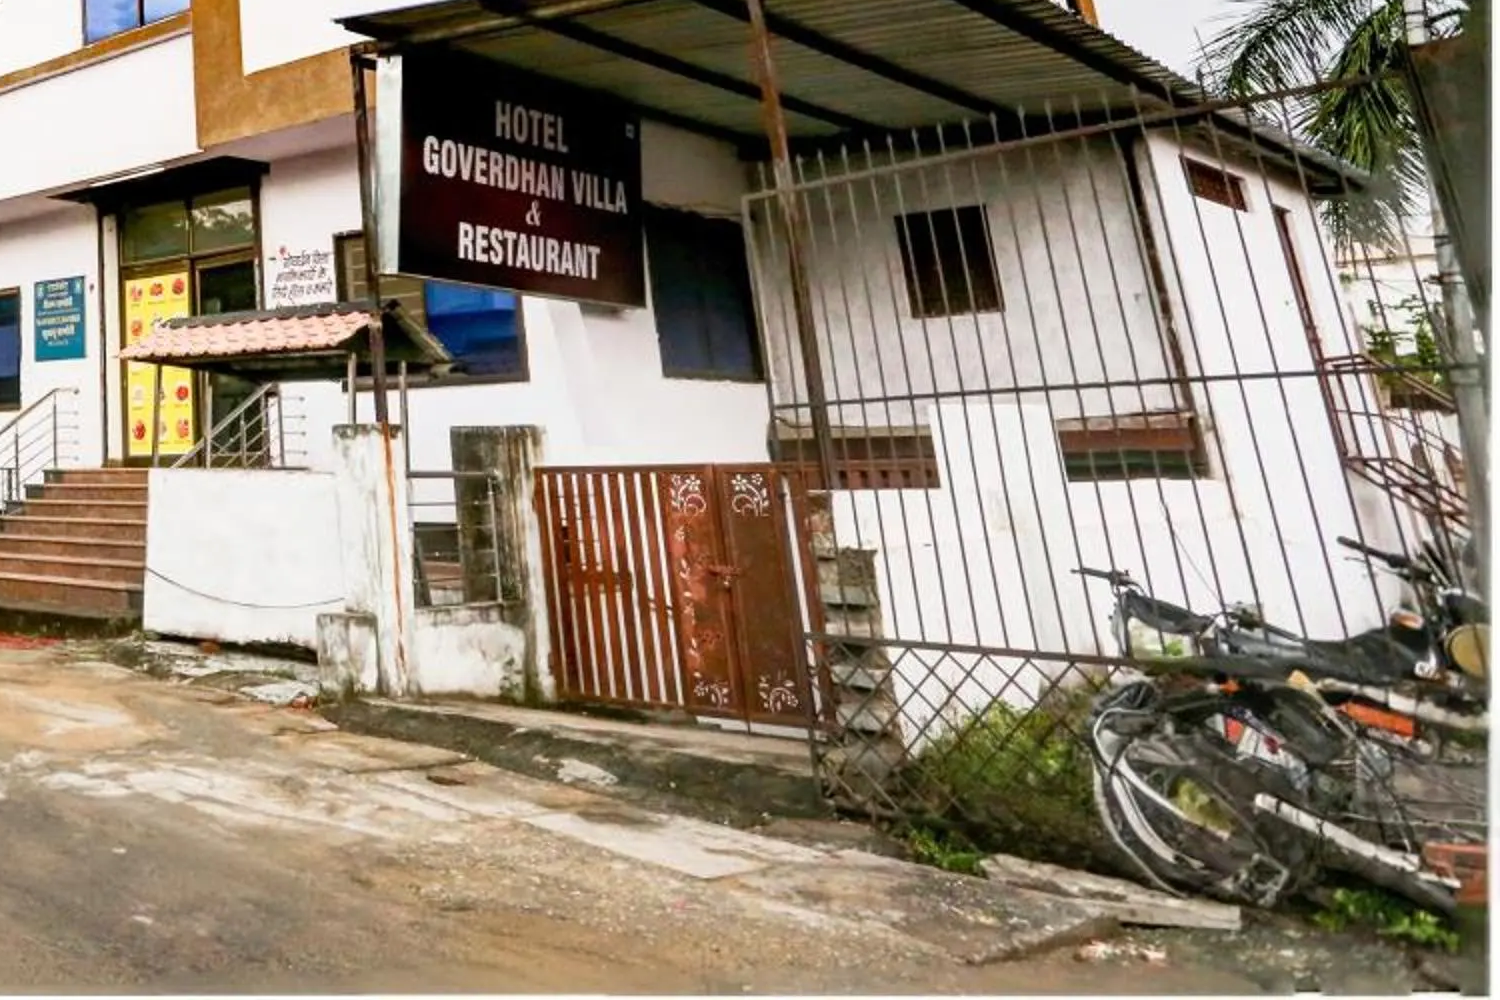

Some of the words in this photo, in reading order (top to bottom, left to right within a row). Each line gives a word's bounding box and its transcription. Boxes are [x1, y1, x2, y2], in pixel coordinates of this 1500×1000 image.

[495, 100, 569, 153] HOTEL
[423, 135, 565, 201] GOVERDHAN
[571, 169, 628, 214] VILLA
[525, 200, 542, 226] &
[457, 221, 601, 280] RESTAURANT
